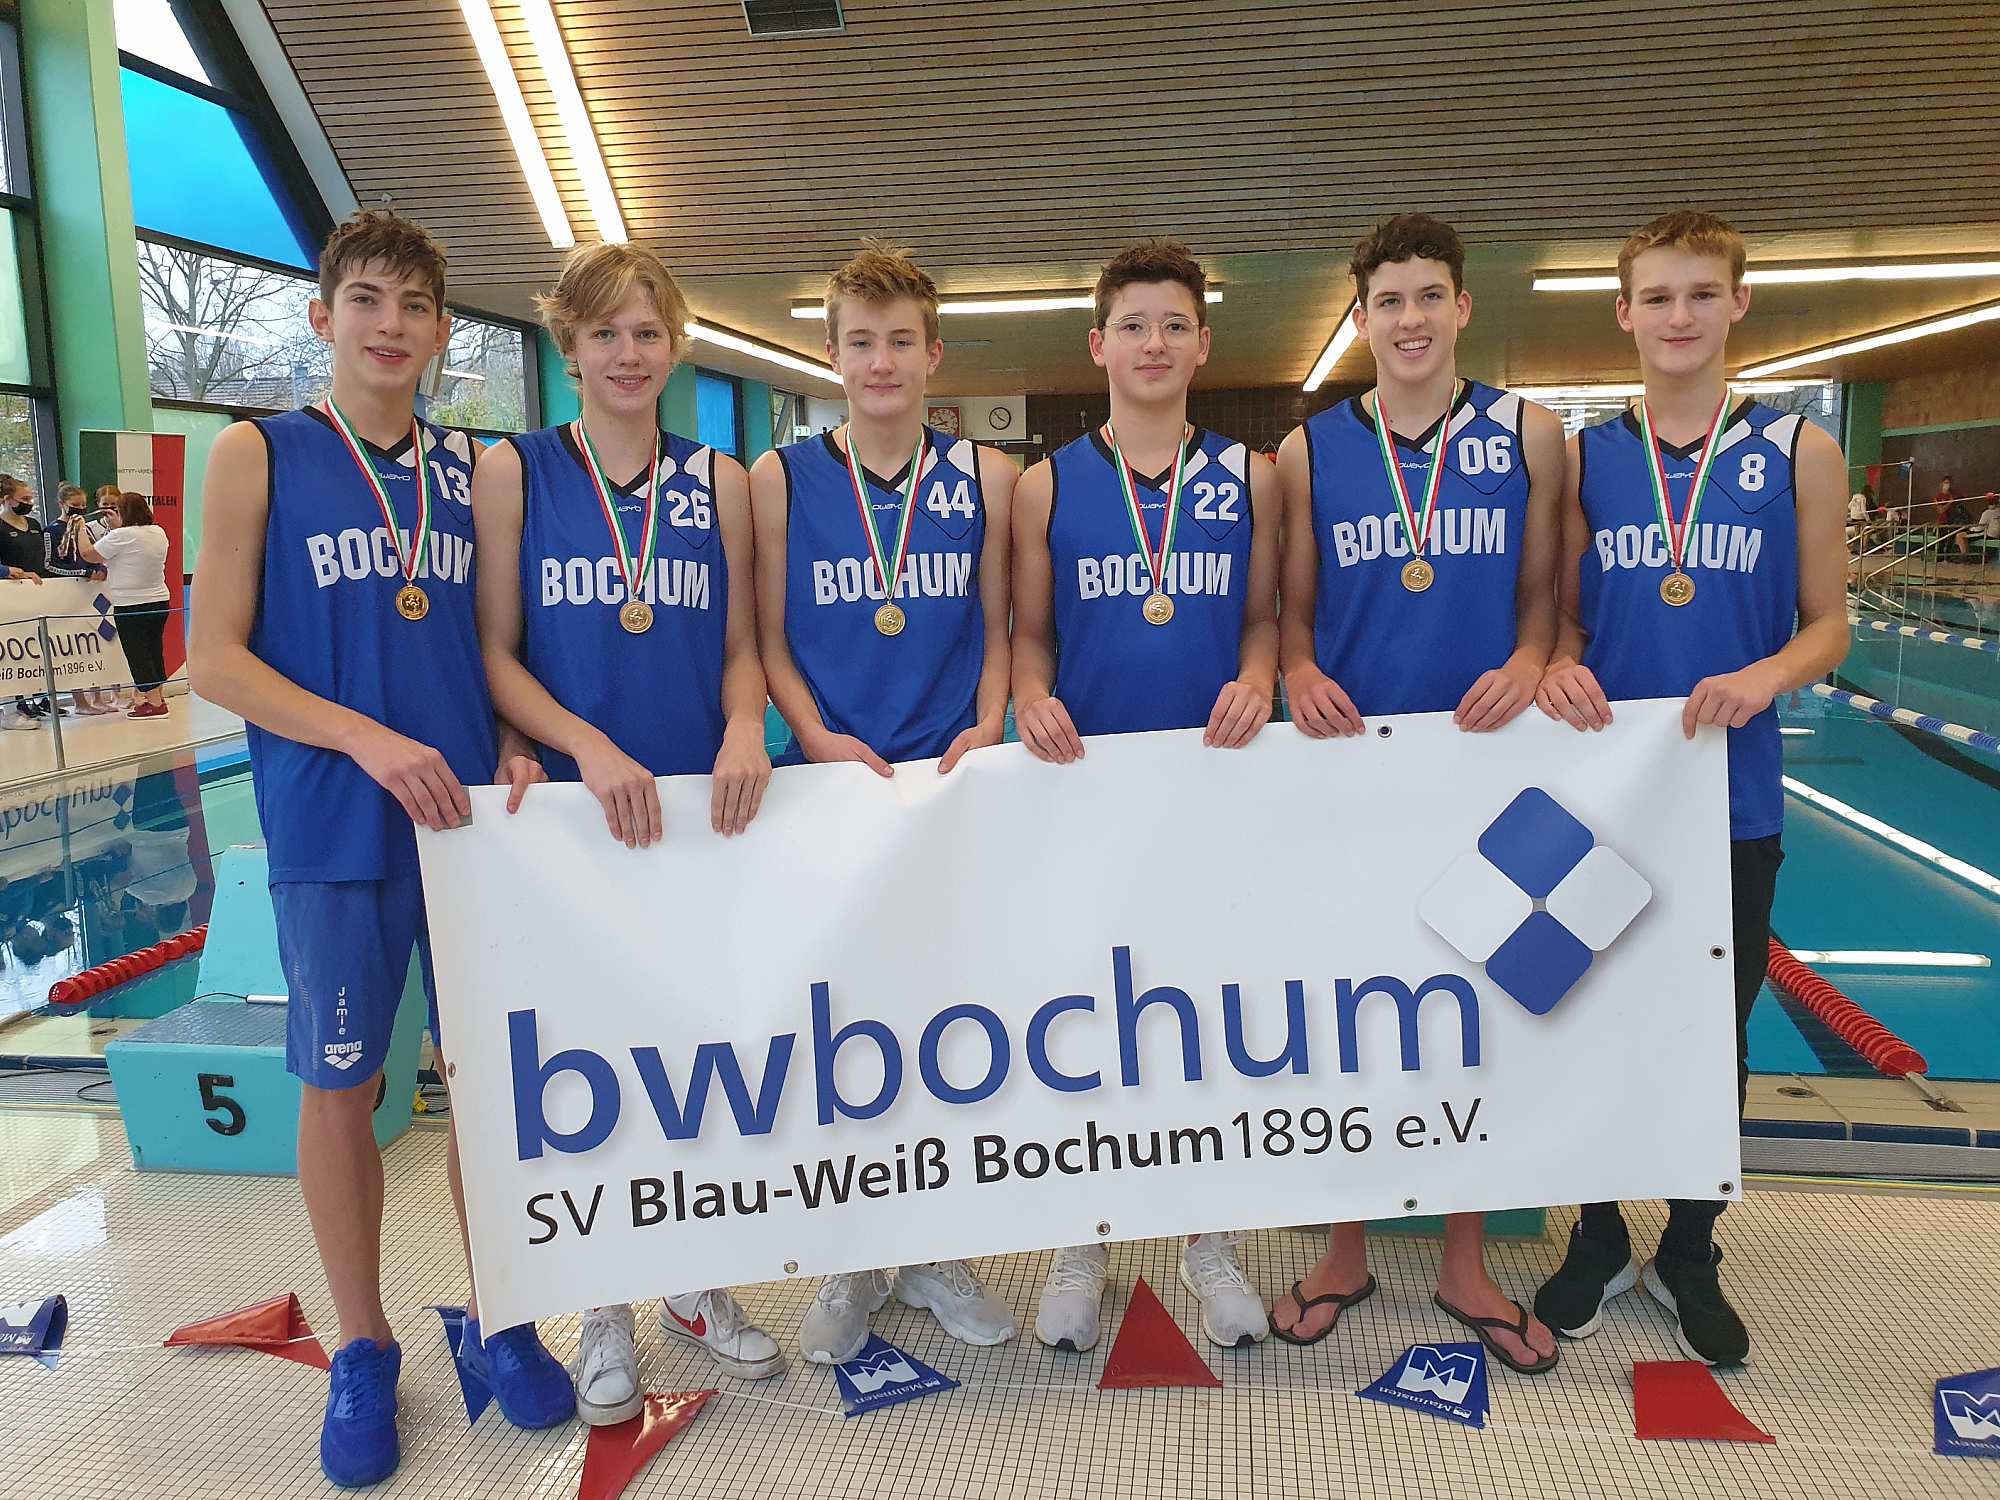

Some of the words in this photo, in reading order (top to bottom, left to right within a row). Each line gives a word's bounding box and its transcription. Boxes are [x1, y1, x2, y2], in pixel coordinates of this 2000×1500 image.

[1458, 435, 1511, 476] 06
[1738, 453, 1766, 491] 8
[429, 460, 471, 506] 13
[926, 480, 976, 519] 44
[1193, 482, 1239, 521] 22
[666, 489, 711, 529] 26
[1332, 508, 1506, 568] BOCHUM
[813, 552, 972, 605] BOCHUM
[336, 986, 347, 1035] Jamie
[325, 1040, 363, 1055] arena
[508, 946, 1481, 1161] bwbochum
[198, 1073, 246, 1136] 5
[526, 1183, 605, 1245] SV
[630, 1135, 950, 1228] Blau-Weiß
[1396, 1097, 1489, 1149] e.V.
[855, 1382, 921, 1404] Malmsten
[1379, 1386, 1452, 1412] Malmsten
